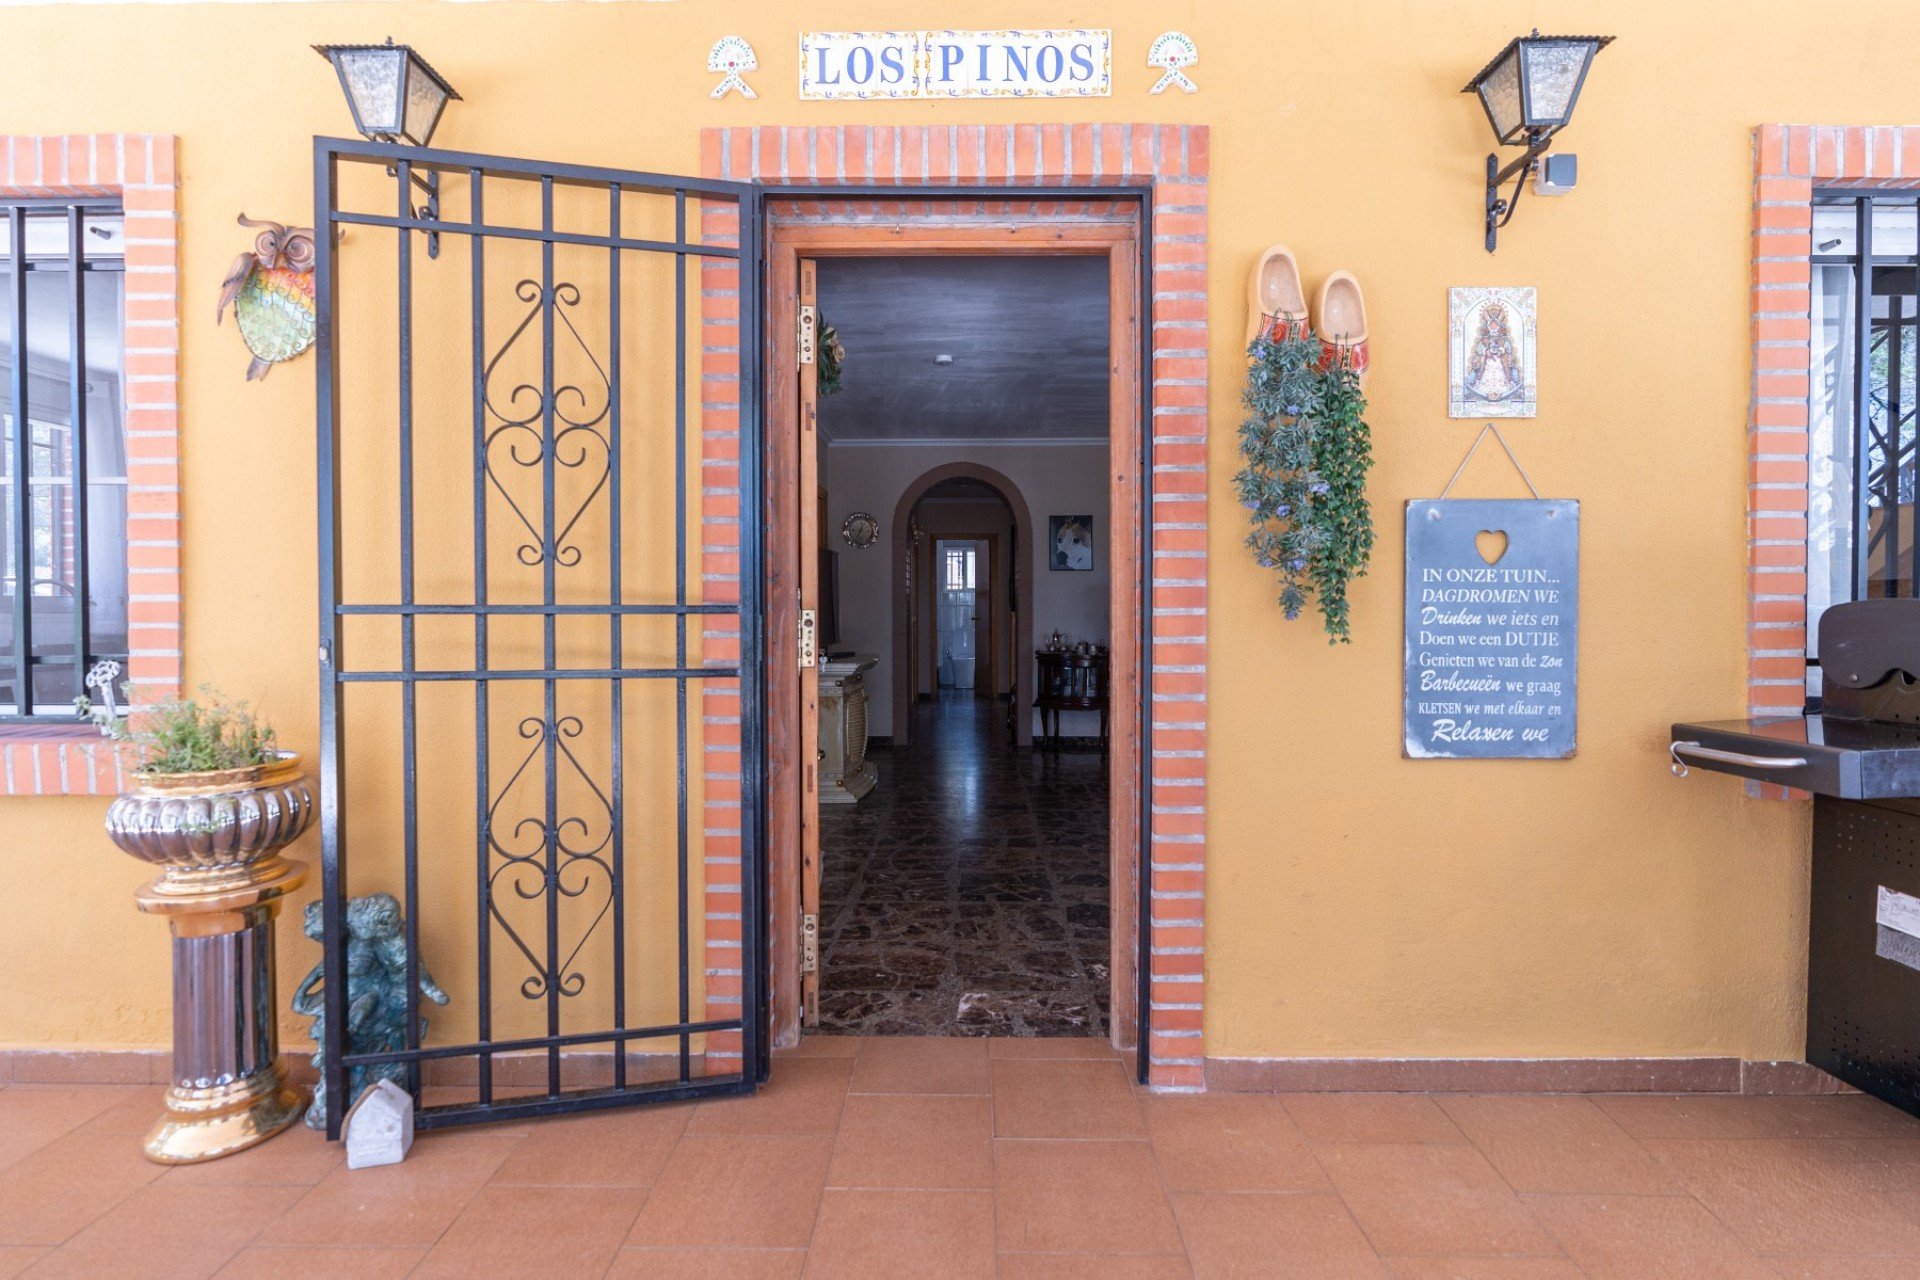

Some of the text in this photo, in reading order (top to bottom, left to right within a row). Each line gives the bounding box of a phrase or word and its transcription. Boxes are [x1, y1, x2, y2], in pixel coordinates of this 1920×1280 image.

[815, 44, 1094, 85] LOS PINOS
[1423, 569, 1442, 582] IN
[1447, 569, 1497, 582] ONZE
[1422, 590, 1559, 603] DAGDROMEN WE
[1422, 607, 1559, 625] Drinken we iets en
[1420, 632, 1558, 646] Doen we een DUTJE
[1420, 653, 1474, 667] Genieten
[1477, 656, 1495, 667] we
[1498, 656, 1518, 667] van
[1522, 653, 1536, 667] de
[1421, 671, 1561, 695] Barbecueën we graag
[1419, 701, 1561, 714] KLETSEN we met elkaar en
[1432, 719, 1548, 741] Relaxen we
